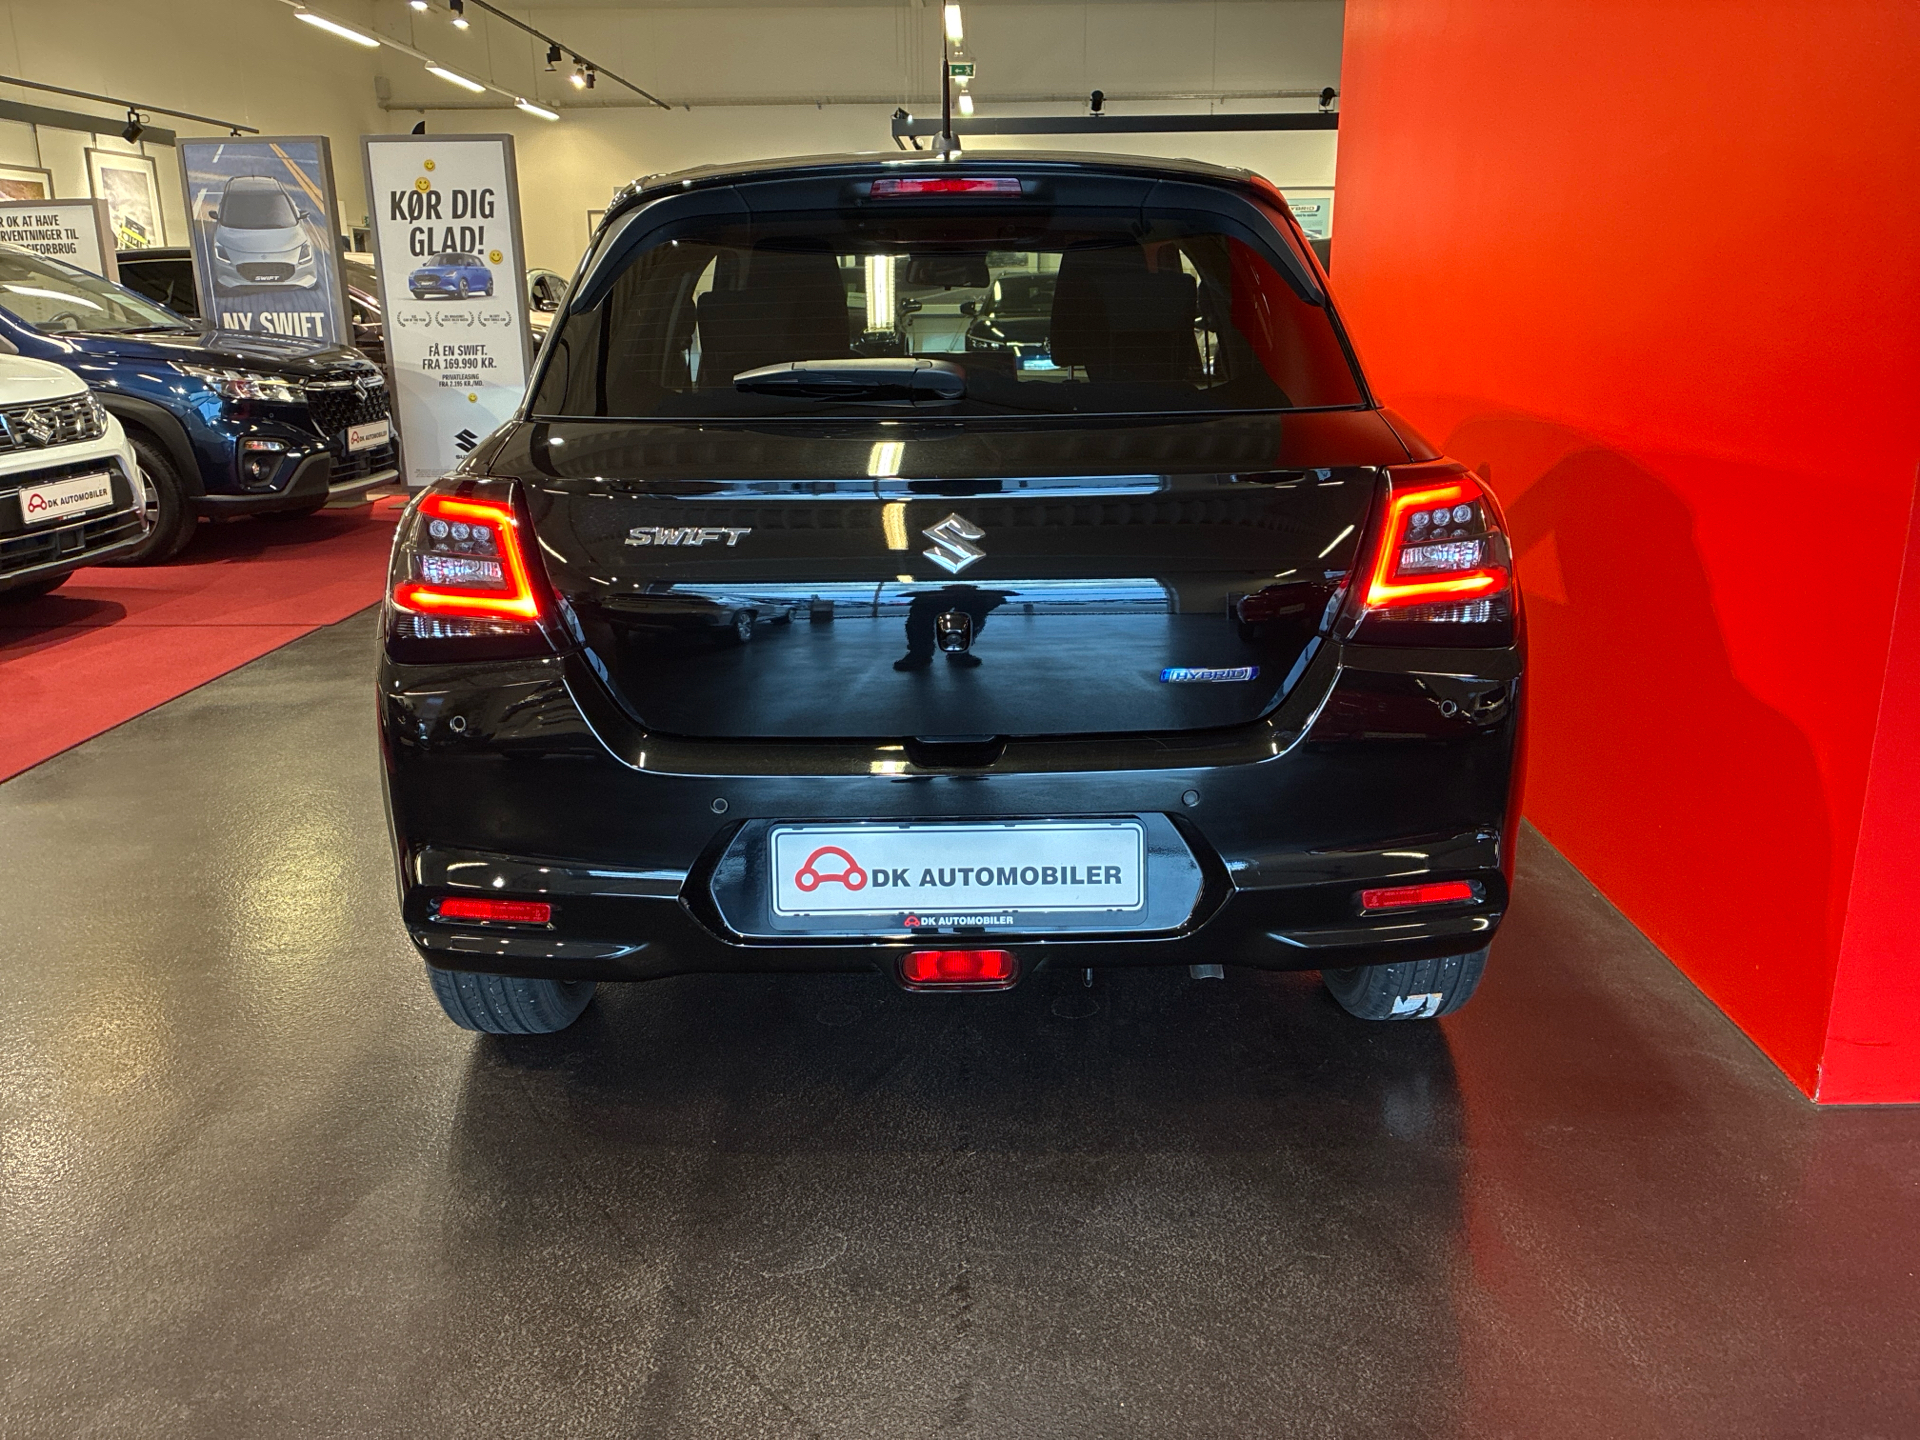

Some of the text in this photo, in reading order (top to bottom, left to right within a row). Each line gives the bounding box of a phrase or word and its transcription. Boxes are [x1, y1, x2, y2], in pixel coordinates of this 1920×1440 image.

[390, 188, 495, 225] KØR DIG
[6, 216, 20, 228] OK
[22, 215, 33, 227] AT
[35, 214, 60, 226] HAVE
[64, 228, 79, 240] TIL
[409, 225, 485, 257] GLAD!
[222, 311, 325, 338] NY SWIFT
[428, 342, 488, 357] FÅ EN SWIFT.
[422, 357, 497, 370] FRA 169.990 KR.
[48, 488, 108, 508] DK AUTOMOBILER
[624, 526, 752, 547] SWIFT
[1174, 668, 1249, 681] HYBRID
[871, 865, 1123, 888] DK AUTOMOBILER
[920, 915, 1014, 926] DK AUTOMOBILER
